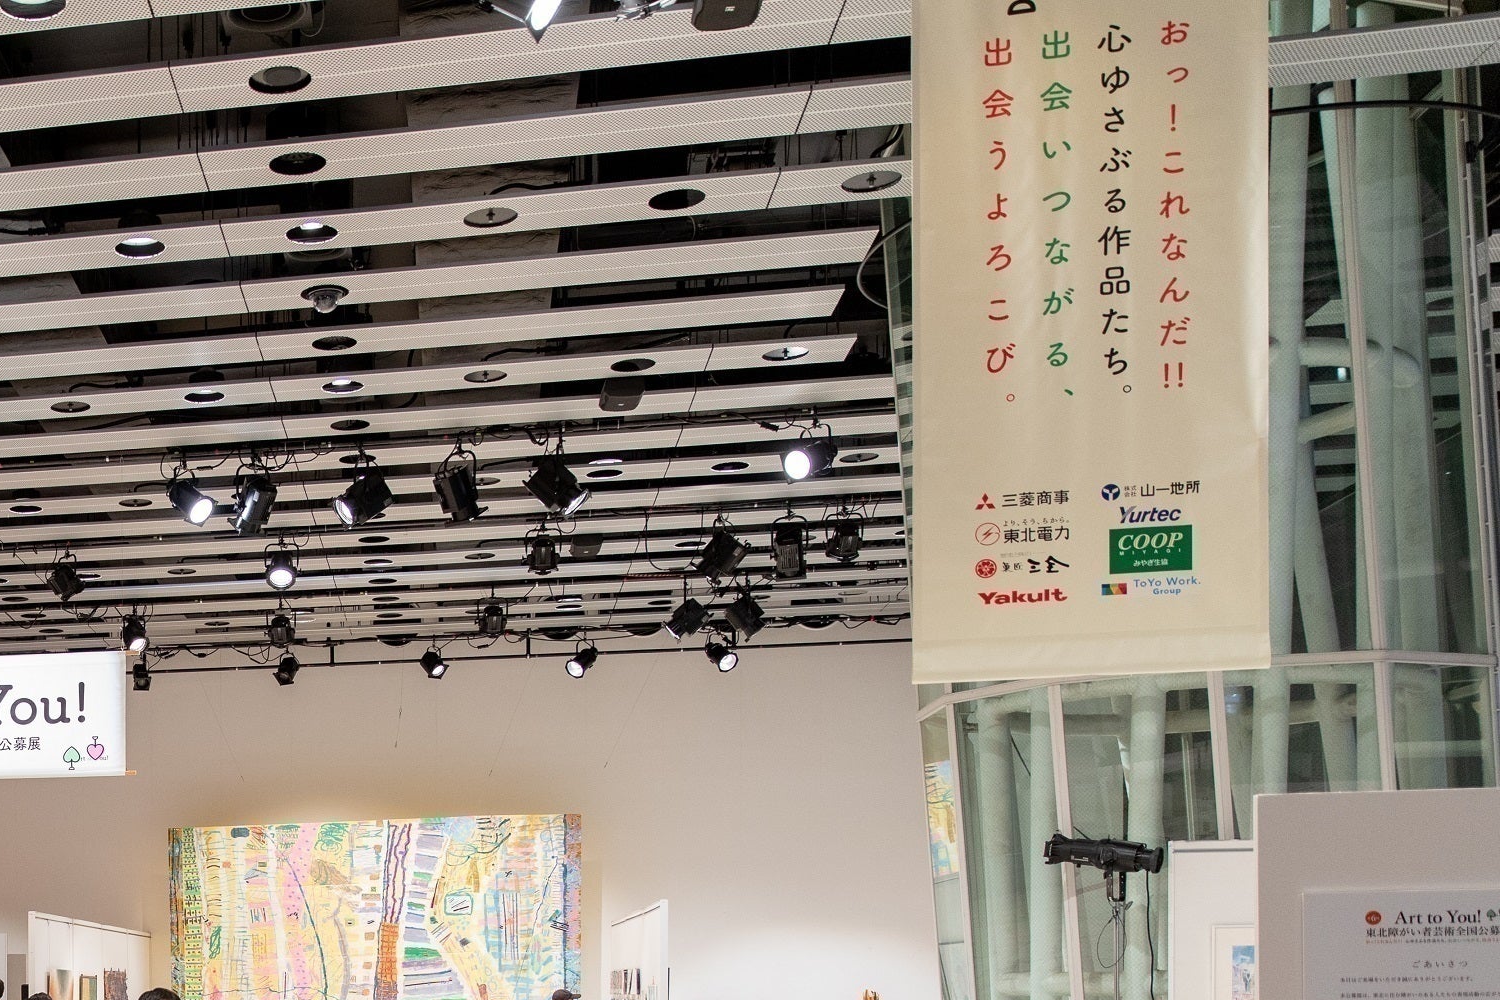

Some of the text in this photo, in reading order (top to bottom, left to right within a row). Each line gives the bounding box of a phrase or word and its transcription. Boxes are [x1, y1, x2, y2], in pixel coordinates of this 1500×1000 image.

[1040, 30, 1074, 396] 出会いつながる、
[1097, 24, 1132, 394] 心ゆさぶる作品たち。
[982, 37, 1016, 402] 出会うよろこび。
[1140, 480, 1201, 497] 山一地所
[1001, 489, 1070, 508] 三菱商事
[1119, 506, 1182, 524] Yurtec
[1003, 526, 1070, 544] 東北電力
[1118, 531, 1184, 551] COOP
[978, 588, 1068, 605] Yakult
[1153, 587, 1181, 595] Group
[1395, 911, 1422, 925] Art
[1427, 912, 1443, 925] to
[1447, 909, 1481, 924] You!
[1412, 960, 1468, 969] ごあいさつ
